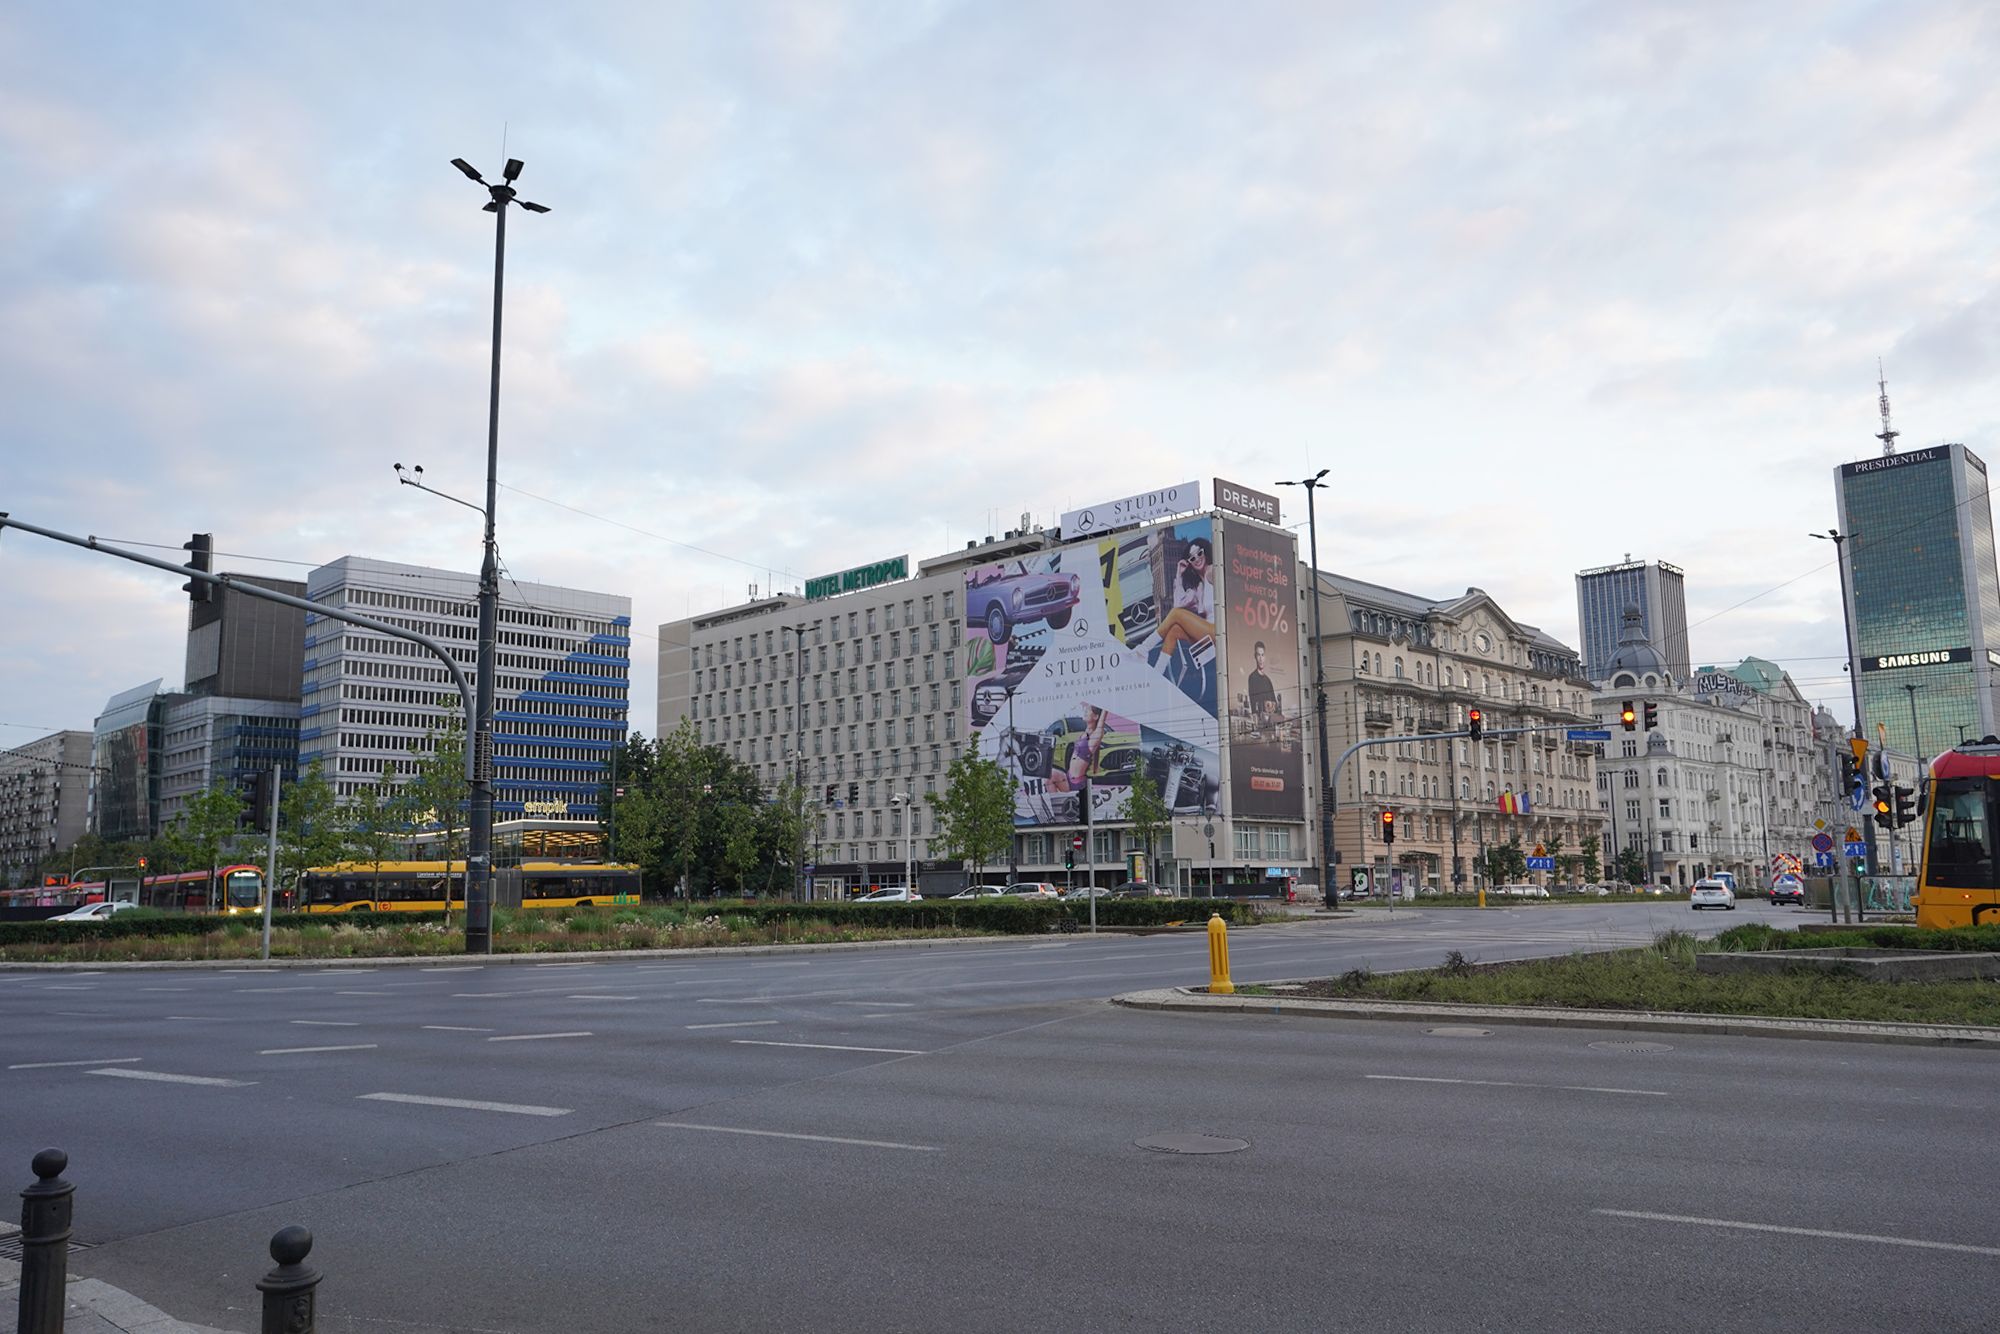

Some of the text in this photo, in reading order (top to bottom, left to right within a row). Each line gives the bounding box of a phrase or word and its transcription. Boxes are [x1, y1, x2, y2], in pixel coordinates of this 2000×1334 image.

[1855, 450, 1936, 473] PRESIDENTIAL
[1114, 488, 1178, 515] STUDIO
[1223, 487, 1274, 516] DREAME
[1236, 544, 1258, 559] Brand
[805, 559, 906, 600] HOTEL METROPOL
[1232, 559, 1288, 586] Super Sale
[1234, 597, 1288, 633] -60%
[1058, 641, 1105, 655] Mercedes-Benz
[1879, 651, 1950, 668] SAMSUNG
[1045, 652, 1120, 678] STUDIO
[1056, 675, 1111, 688] WARSZAWA
[524, 798, 568, 816] empik
